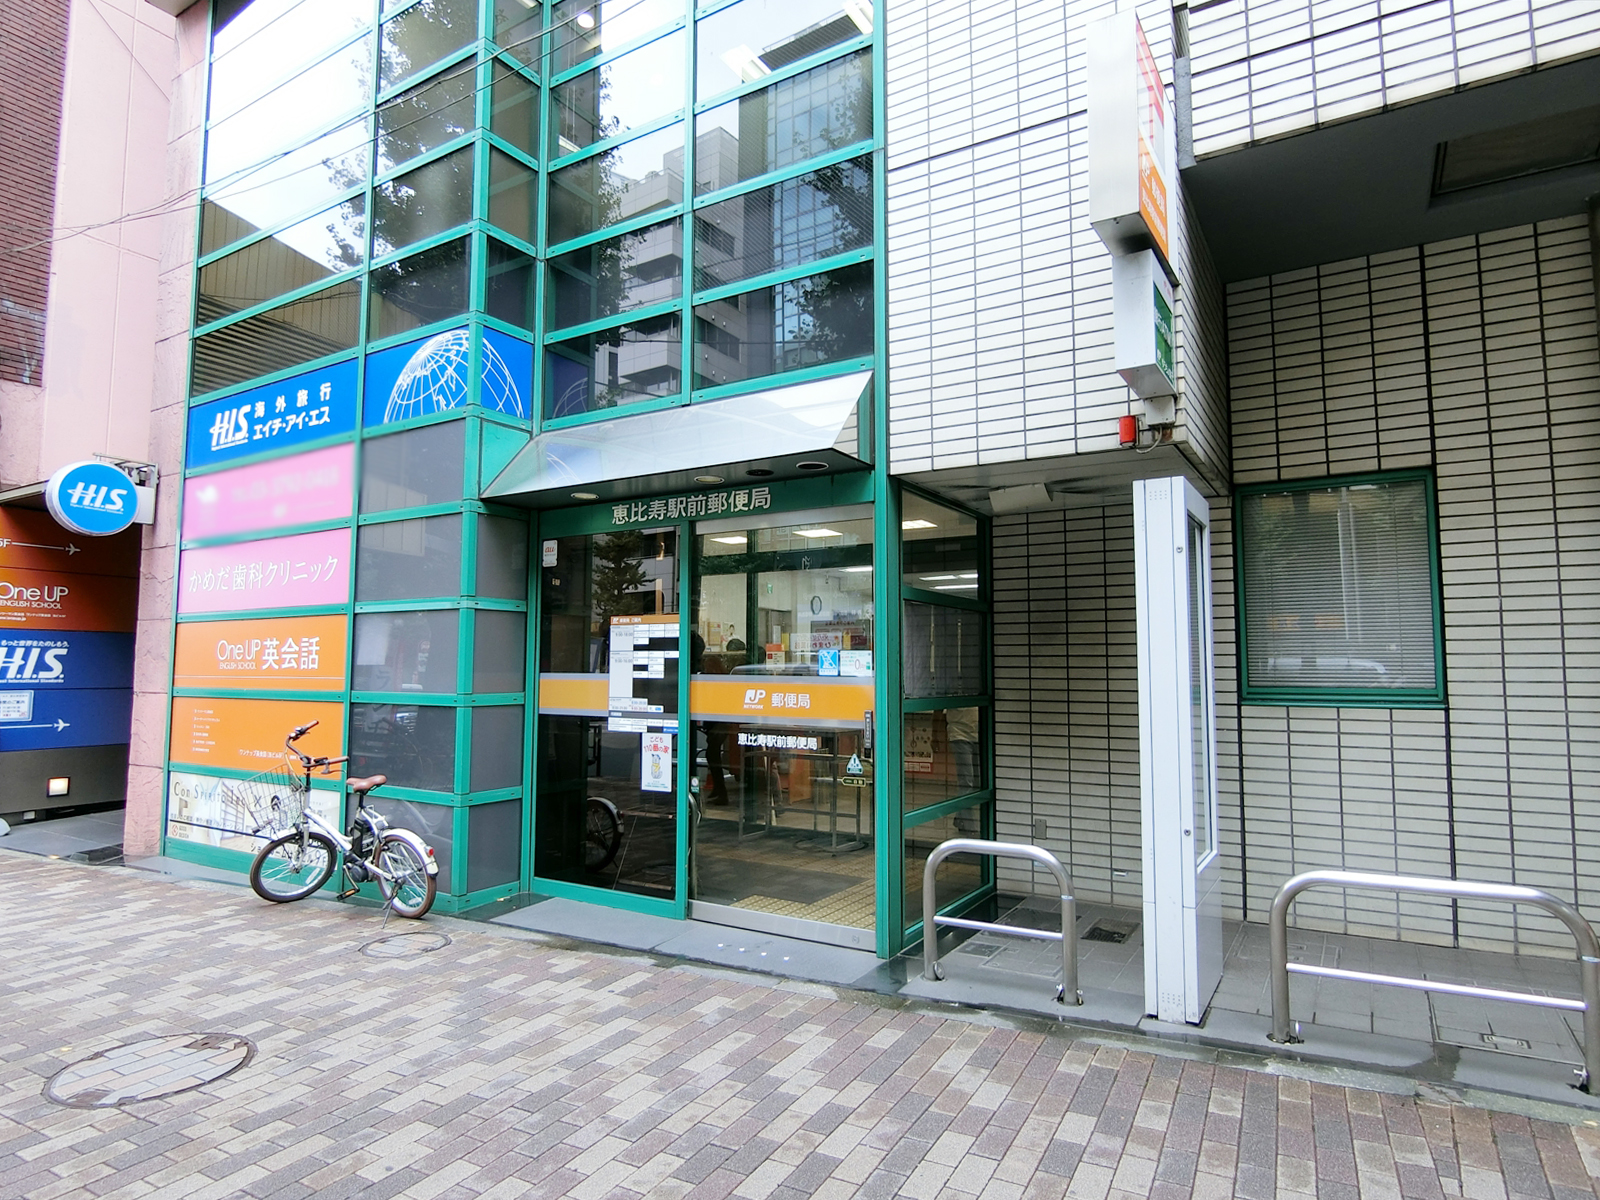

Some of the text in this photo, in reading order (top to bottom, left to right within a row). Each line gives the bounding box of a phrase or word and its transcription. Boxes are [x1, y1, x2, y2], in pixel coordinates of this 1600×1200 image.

[254, 382, 332, 418] 海外旅行
[253, 406, 331, 440] エイチ・アイ・エス
[67, 481, 128, 512] H.I.S.
[611, 487, 771, 525] 恵比寿駅前郵便局
[189, 555, 339, 593] かめだ歯科クリニック
[0, 581, 69, 602] One UP
[217, 639, 262, 661] One UP
[261, 636, 321, 670] 英会話
[744, 689, 767, 704] JP
[771, 692, 811, 709] 郵便局
[737, 732, 818, 750] 恵比寿駅前郵便局
